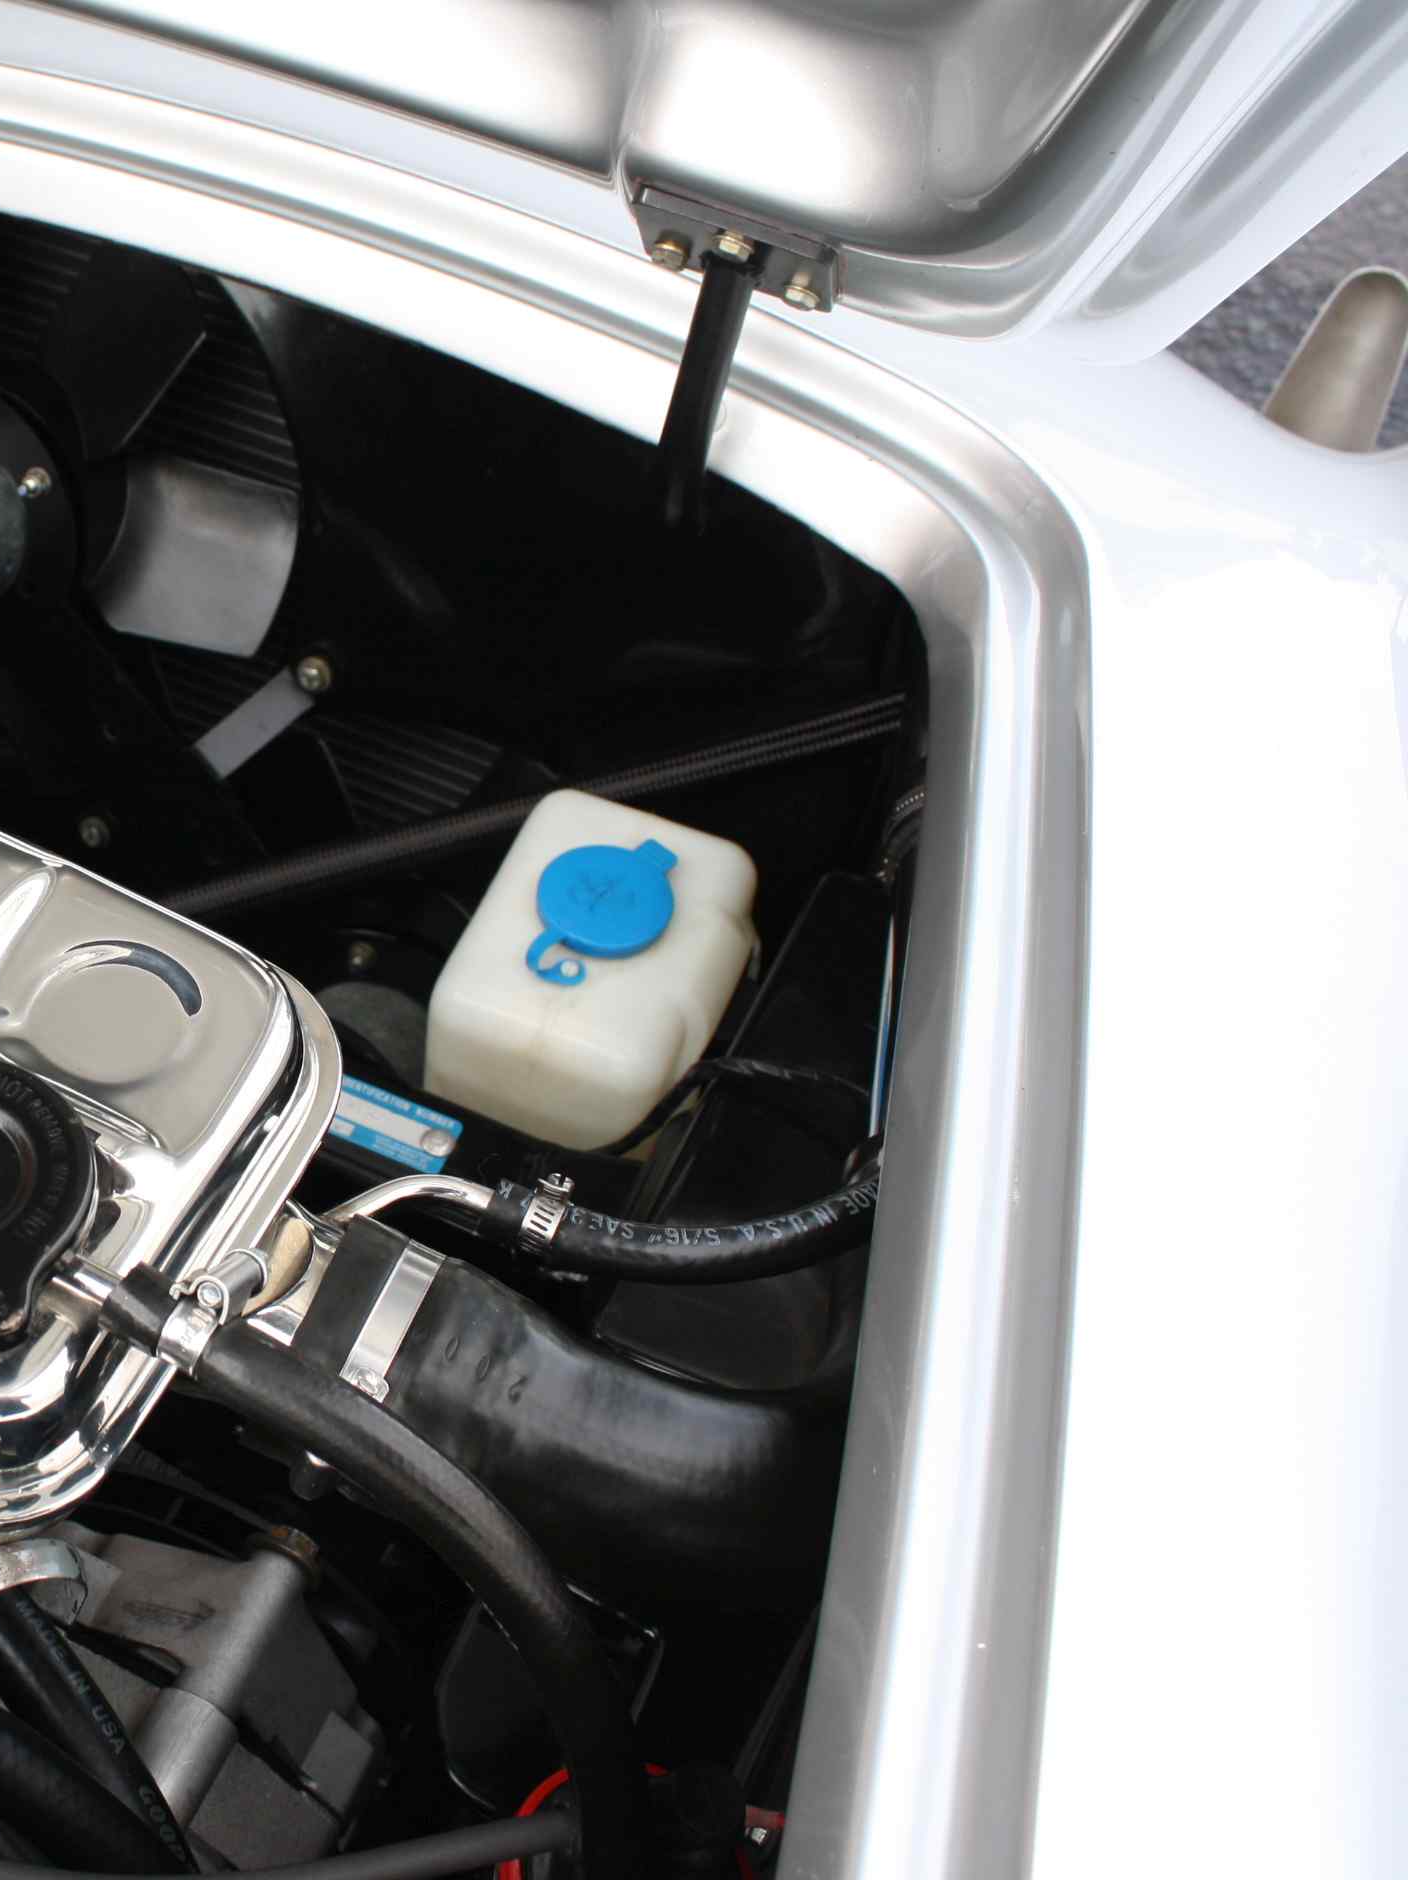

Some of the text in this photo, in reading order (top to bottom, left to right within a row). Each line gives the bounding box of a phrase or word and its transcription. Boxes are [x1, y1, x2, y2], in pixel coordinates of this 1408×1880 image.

[841, 1181, 879, 1215] ADE
[588, 1214, 635, 1240] SAE
[812, 1203, 839, 1228] IN
[91, 1703, 126, 1756] USA
